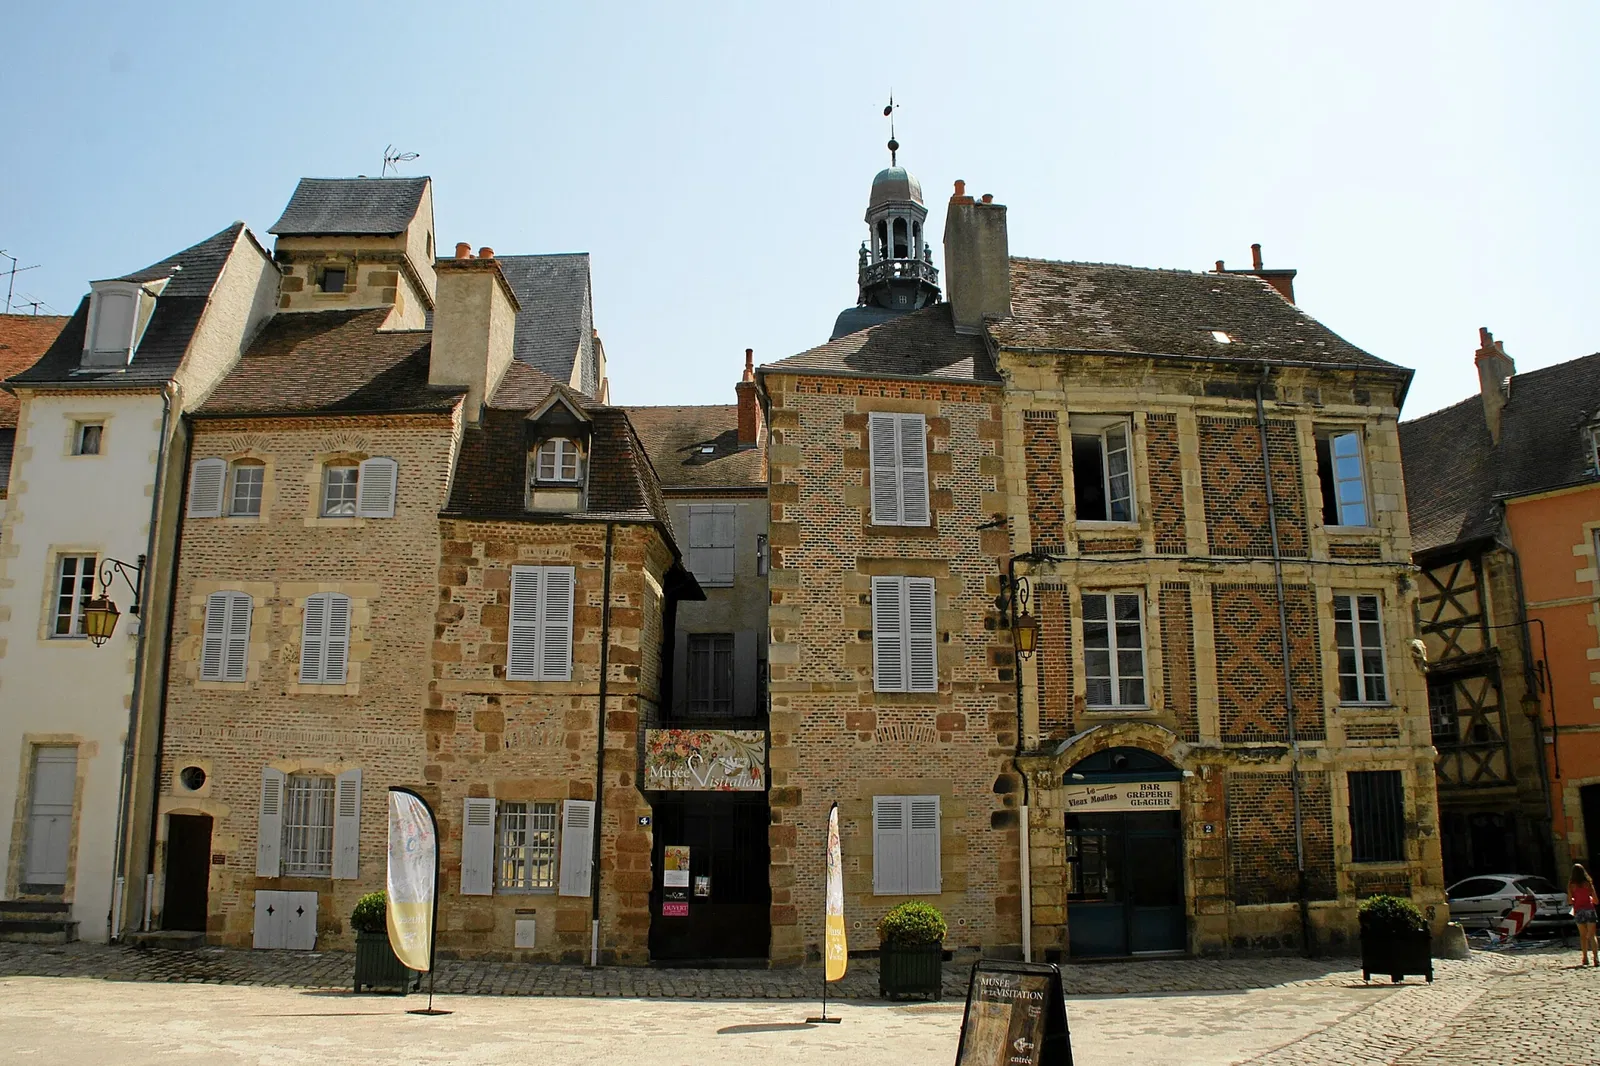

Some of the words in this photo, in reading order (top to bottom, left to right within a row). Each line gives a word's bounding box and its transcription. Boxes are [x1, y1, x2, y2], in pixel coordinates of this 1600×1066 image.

[650, 765, 690, 778] Musée
[687, 750, 760, 787] Visitation
[1140, 783, 1160, 791] BAR
[1068, 798, 1088, 807] Vieux
[1090, 793, 1117, 804] Moulins
[640, 817, 648, 825] 4
[996, 988, 1044, 1000] VISITATION
[1010, 1055, 1032, 1065] entrée
